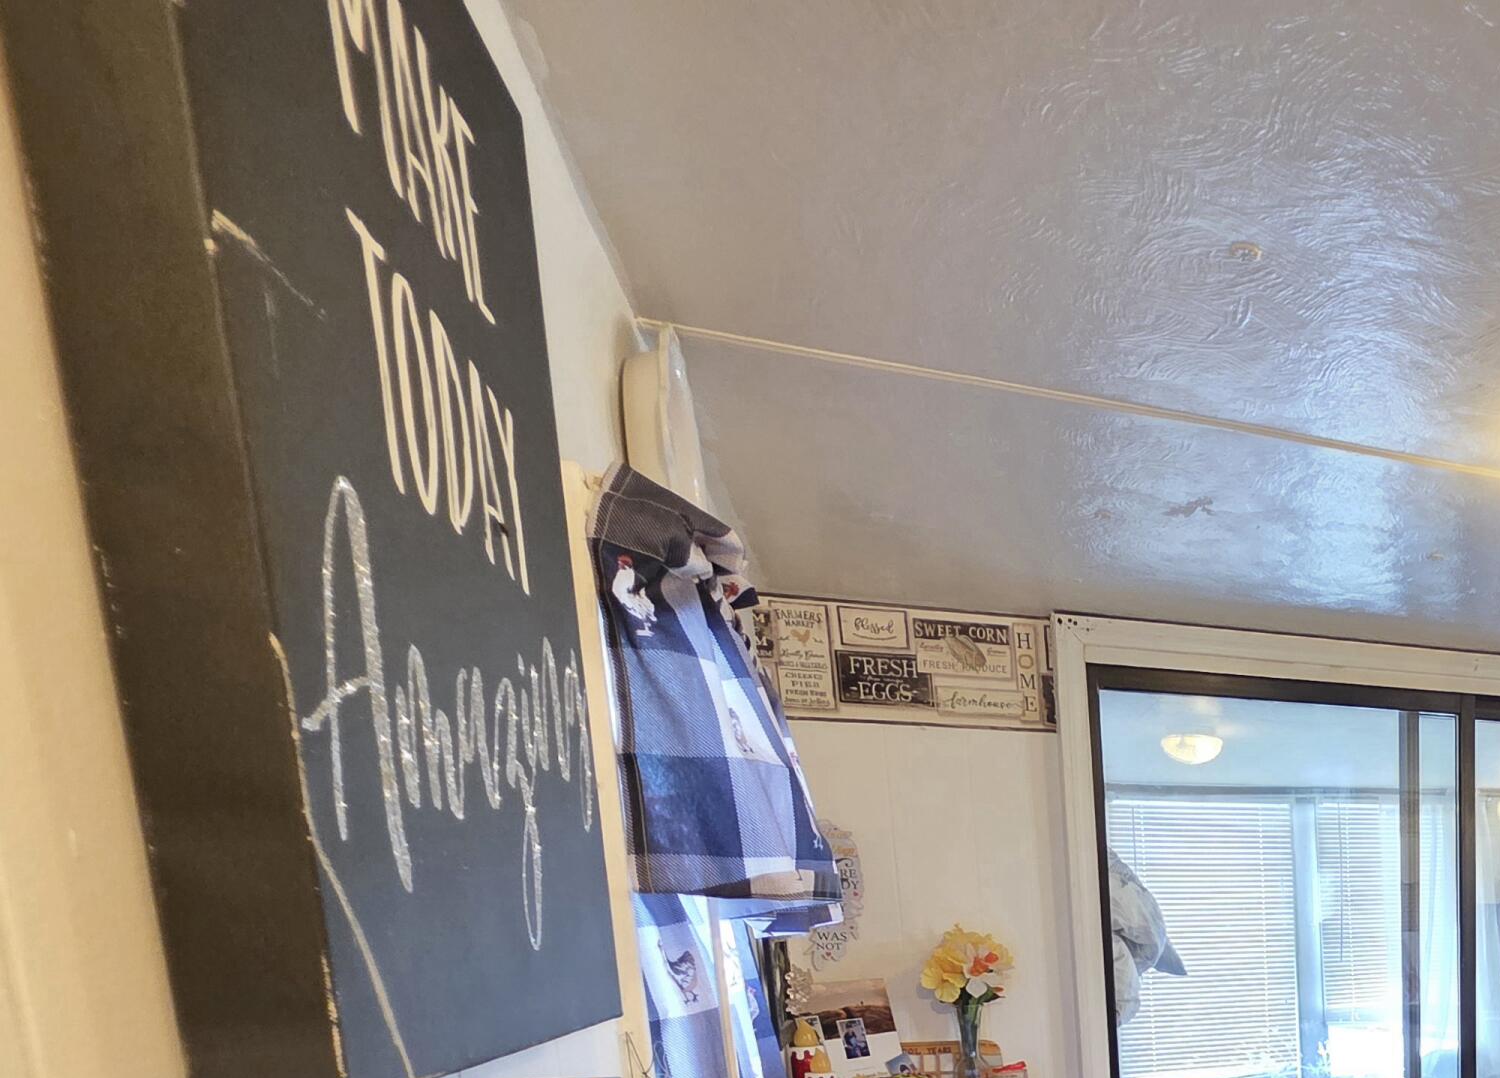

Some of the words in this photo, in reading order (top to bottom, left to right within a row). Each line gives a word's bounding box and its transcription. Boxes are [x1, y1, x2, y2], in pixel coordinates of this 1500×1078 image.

[345, 207, 531, 597] TODAY
[774, 608, 822, 625] FARMERS
[785, 619, 815, 630] MARKET
[914, 621, 962, 638] SWEET
[968, 626, 1008, 645] CORN
[849, 656, 919, 679] FRESH
[923, 659, 955, 670] FRESH
[1015, 632, 1038, 713] HOME
[817, 931, 848, 942] WAS
[816, 942, 842, 951] NOT
